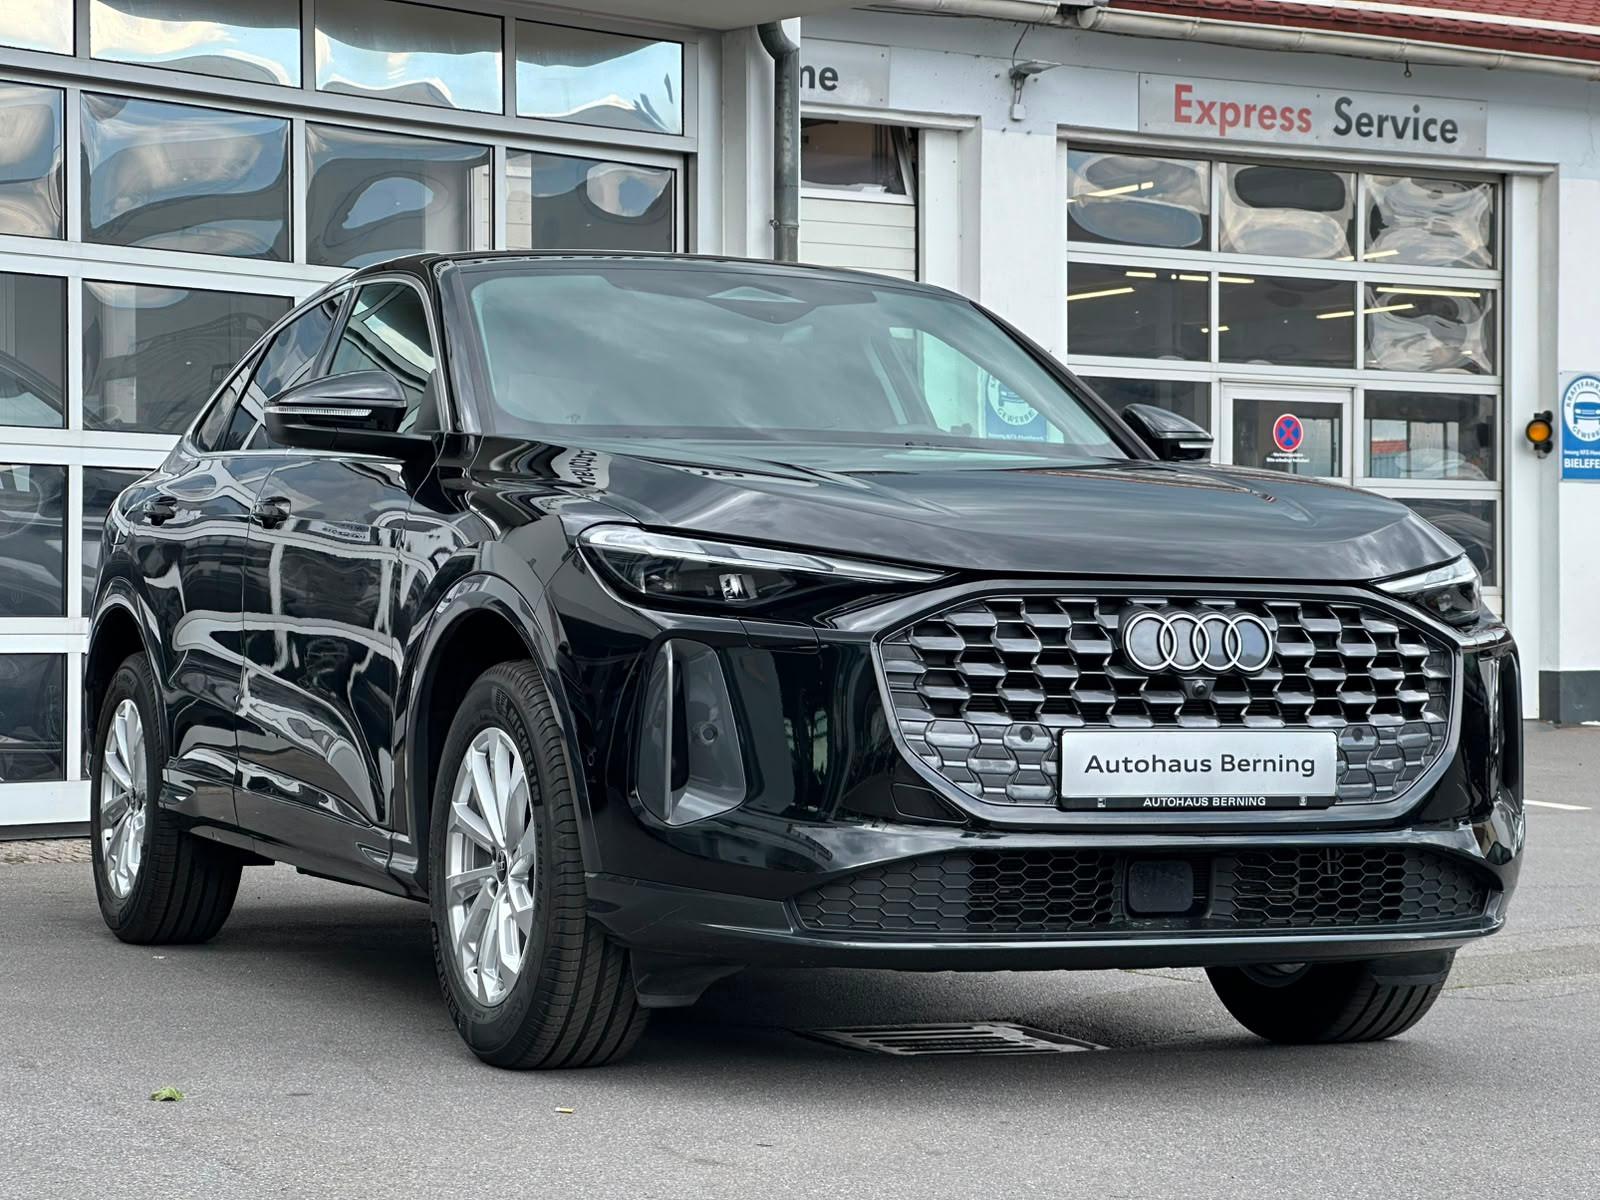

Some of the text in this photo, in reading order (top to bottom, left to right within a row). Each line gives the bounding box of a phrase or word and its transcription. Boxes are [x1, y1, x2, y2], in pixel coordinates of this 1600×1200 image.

[799, 65, 838, 91] ne
[1174, 83, 1458, 143] Express Service
[1564, 458, 1600, 469] BIELEFE
[506, 706, 542, 804] MICHELIN
[1084, 754, 1315, 777] Autohaus Berning
[1143, 796, 1266, 807] AUTOHAUS BERNING
